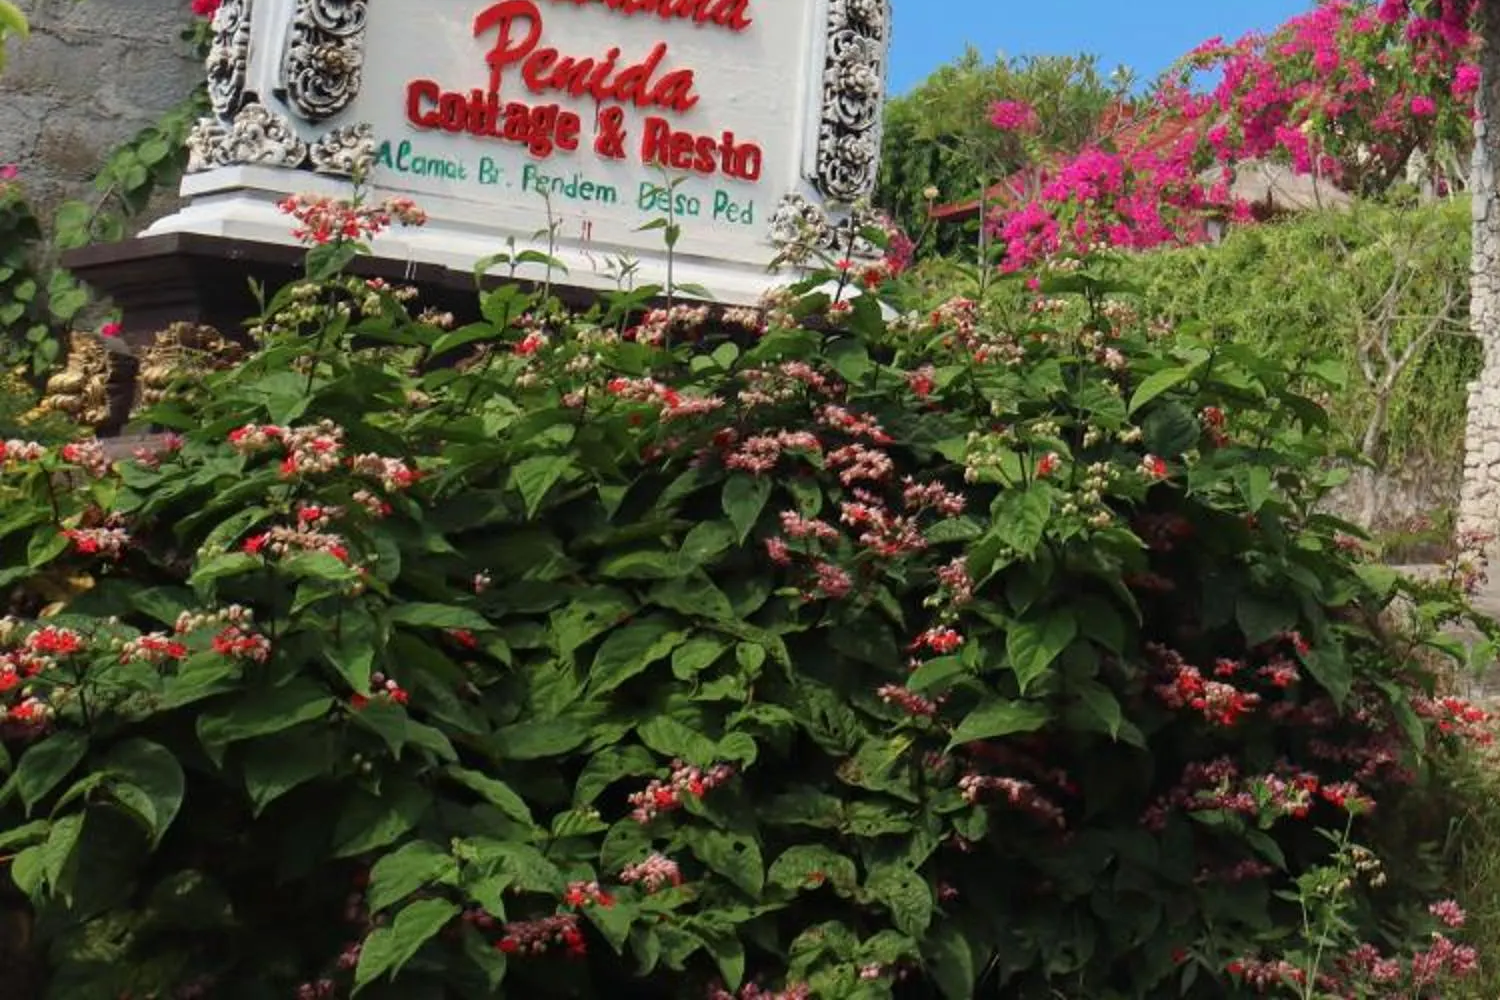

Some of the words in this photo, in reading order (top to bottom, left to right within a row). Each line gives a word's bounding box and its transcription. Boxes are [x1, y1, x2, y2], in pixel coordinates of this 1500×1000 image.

[473, 0, 698, 112] Penida
[406, 80, 581, 157] Cottage
[594, 105, 627, 159] &
[642, 117, 763, 181] Resto
[371, 139, 467, 181] Alamat
[637, 181, 701, 217] Desa
[712, 188, 754, 225] Ped
